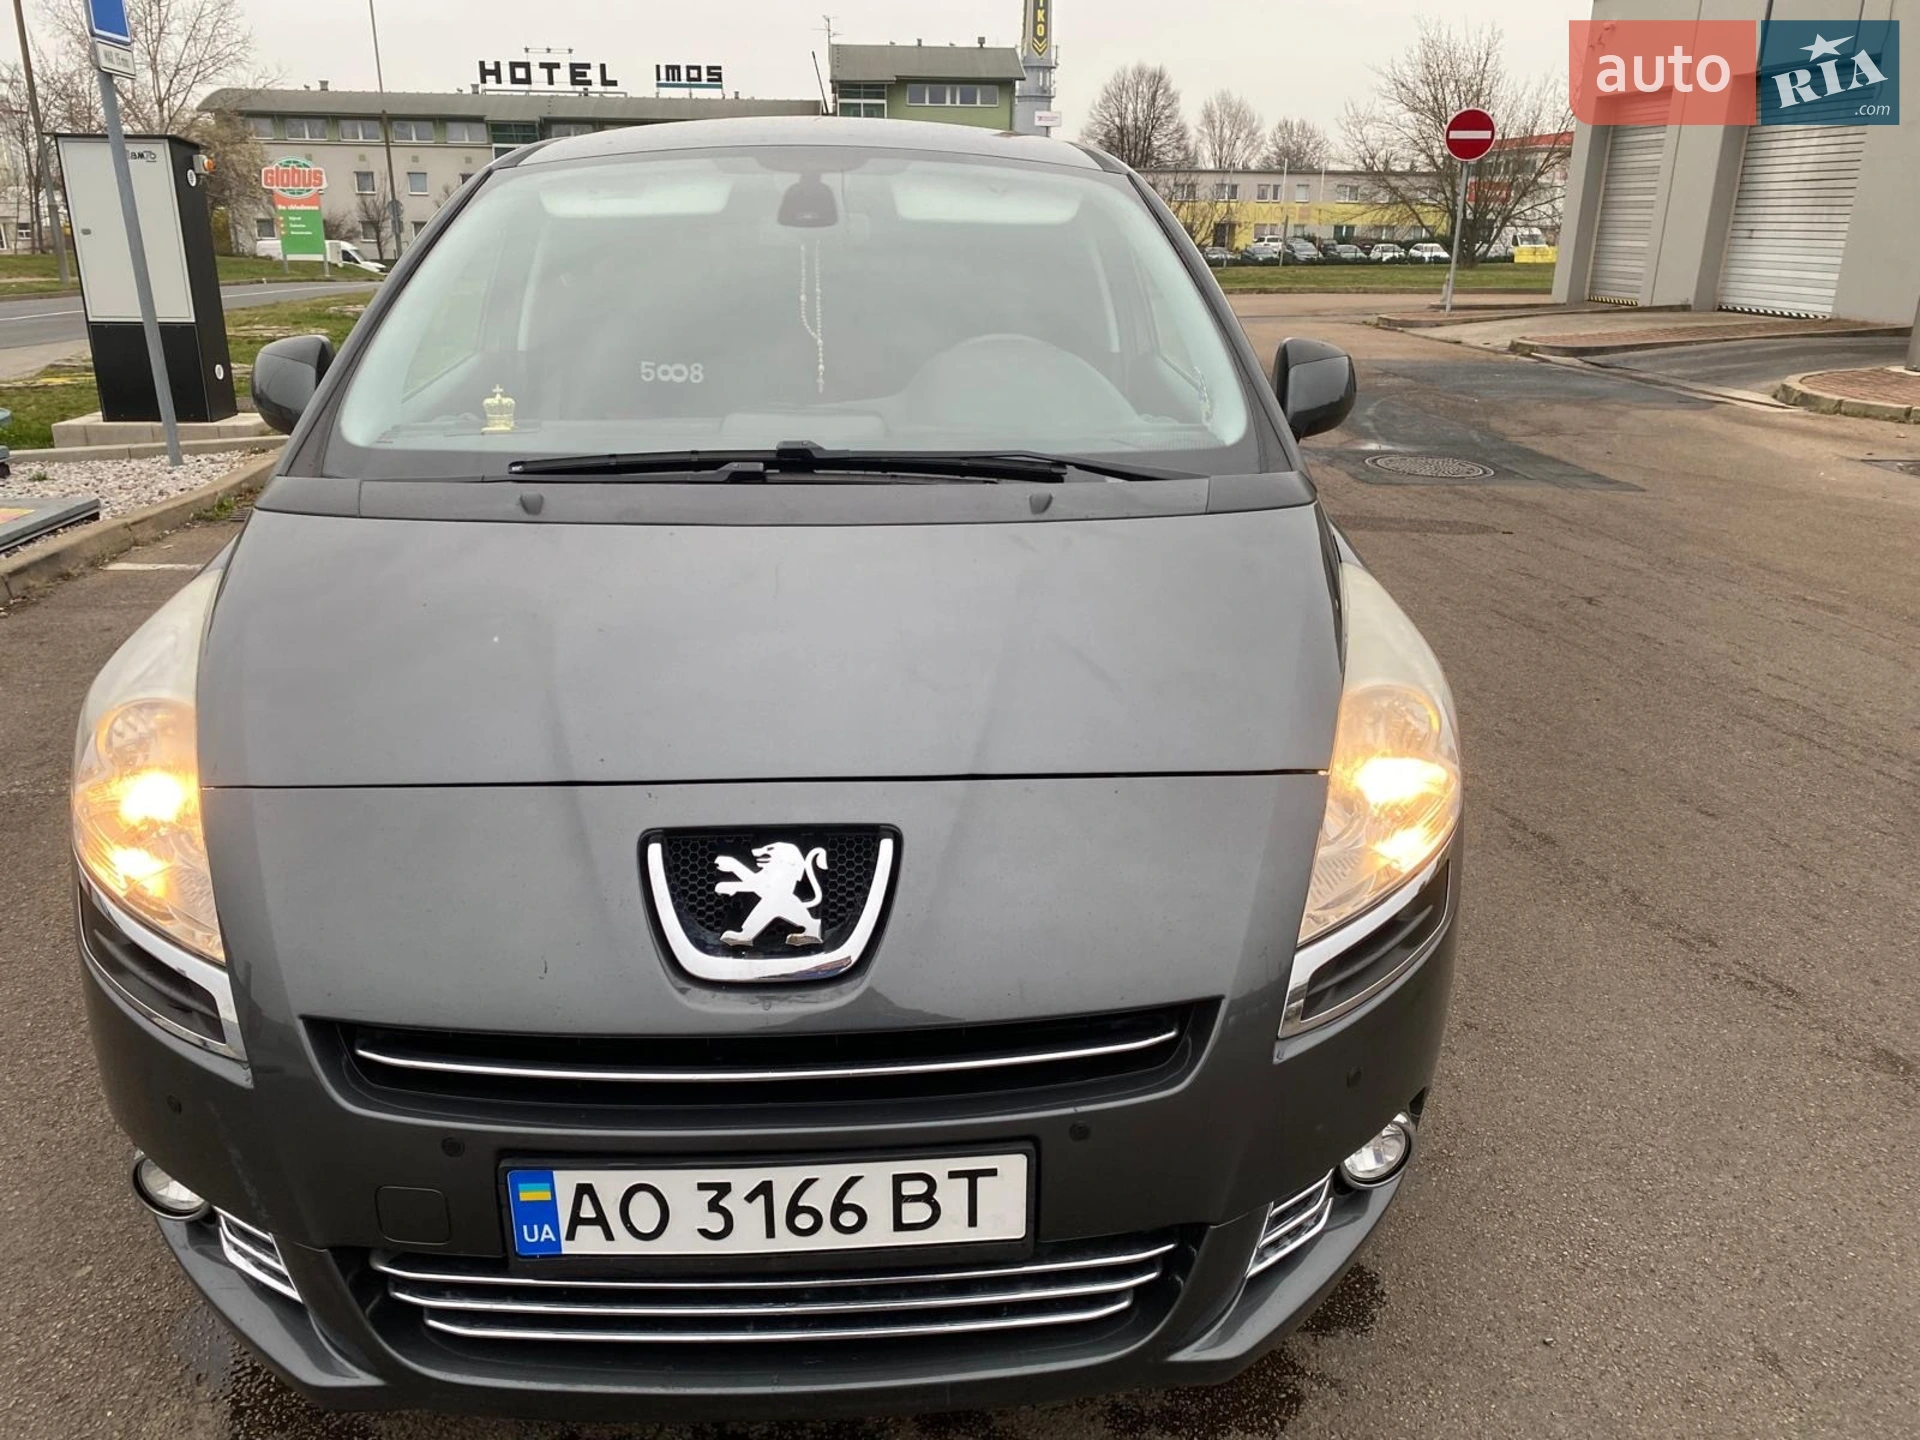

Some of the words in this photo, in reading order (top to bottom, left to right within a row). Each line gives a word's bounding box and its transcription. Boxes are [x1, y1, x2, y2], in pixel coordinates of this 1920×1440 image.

[478, 60, 618, 87] HOTEL
[655, 64, 723, 83] IMOS
[641, 361, 704, 383] 5008
[564, 1182, 670, 1242] AO
[697, 1175, 868, 1240] 3166
[892, 1168, 998, 1232] BT
[523, 1224, 556, 1243] UA
